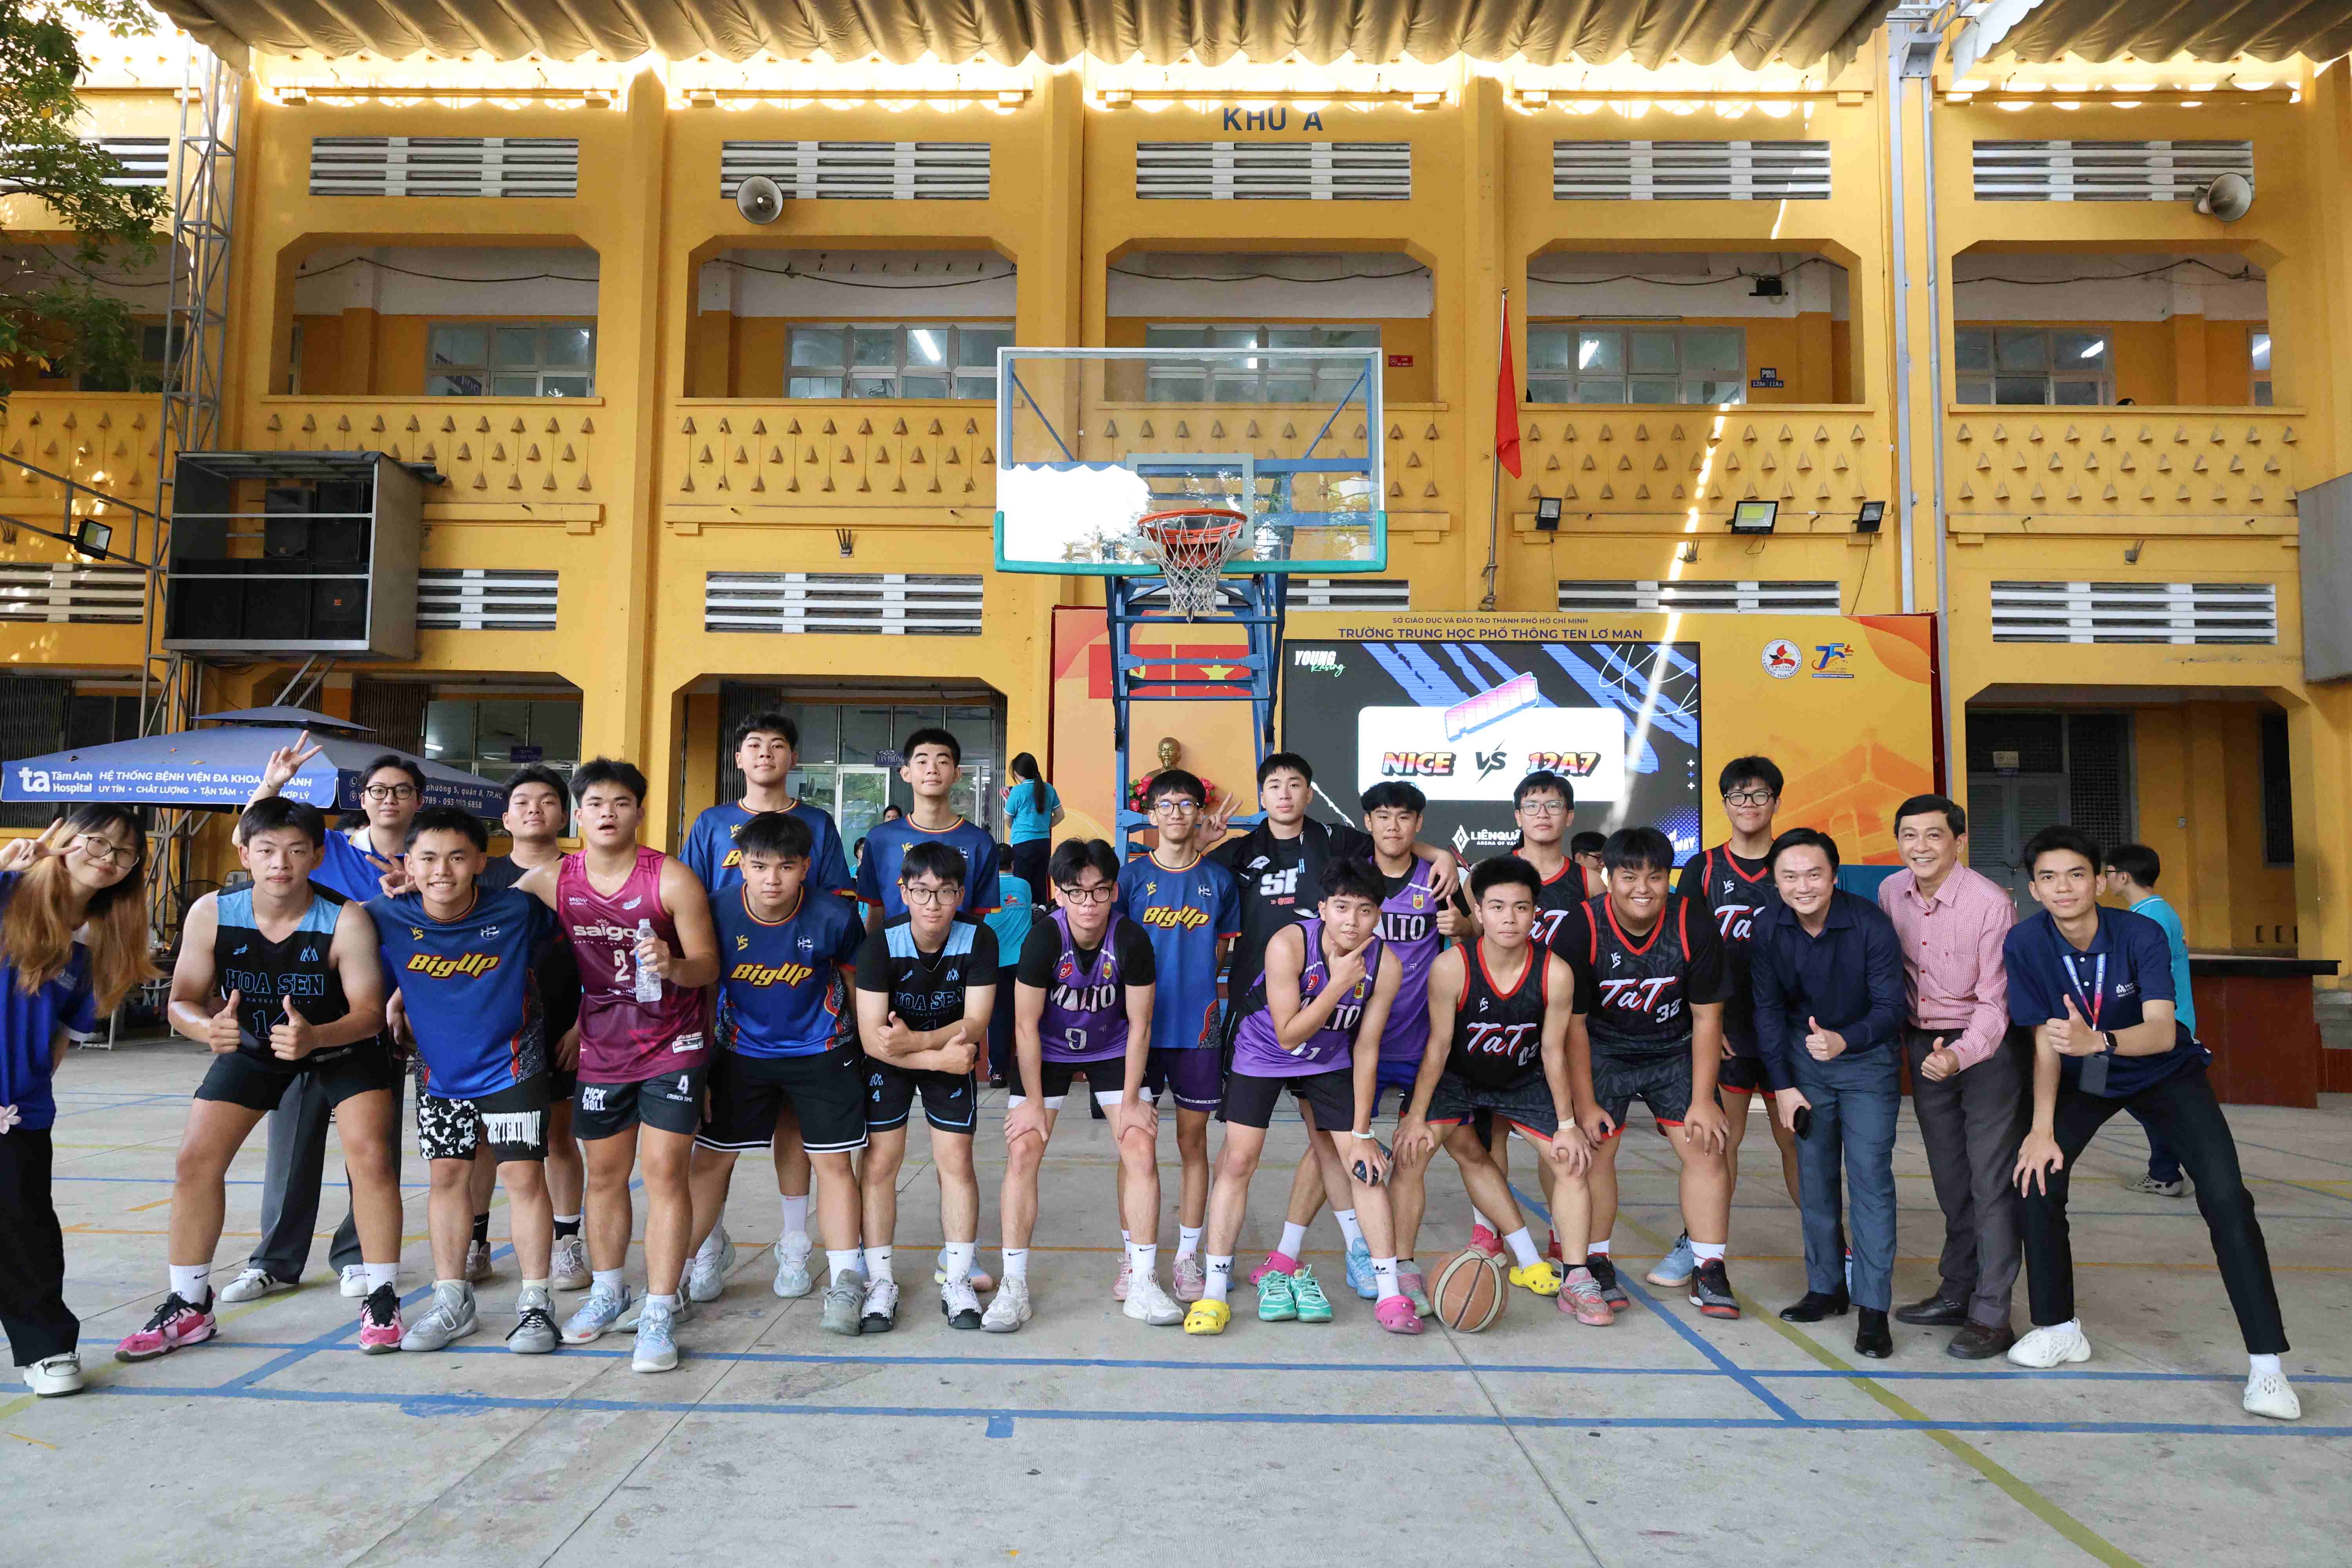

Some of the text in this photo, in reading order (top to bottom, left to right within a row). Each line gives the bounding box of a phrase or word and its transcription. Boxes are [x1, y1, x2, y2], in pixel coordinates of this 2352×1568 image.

[1223, 107, 1323, 131] KHU A
[1392, 615, 1403, 624] SỞ
[1338, 626, 1642, 641] TRƯỜNG TRUNG HỌC PHỔ THÔNG TEN LƠ MAN
[1294, 650, 1337, 666] YOUNG
[1815, 642, 1846, 668] 75
[1310, 664, 1347, 677] Rising
[1381, 751, 1601, 777] NICE VS 12A7
[18, 766, 50, 792] ta
[51, 771, 93, 781] Tâm Anh
[99, 769, 312, 787] HỆ THỐNG BỆNH VIỆN ĐA KHOA ANH
[53, 782, 93, 795] Hospital
[113, 785, 125, 793] TÍN
[136, 785, 158, 794] CHẤT
[159, 786, 189, 796] LƯỢNG
[200, 785, 218, 797] TẬN
[218, 786, 236, 796] TÂM
[279, 790, 298, 800] HỢP
[299, 791, 310, 800] LÝ
[461, 788, 477, 798] quận
[486, 790, 503, 800] TP.HC
[467, 800, 482, 809] 6858
[1470, 829, 1521, 841] LIÊNQUÂ
[1146, 881, 1157, 897] VS
[1723, 880, 1735, 894] VS
[1142, 904, 1210, 930] BigUp
[1528, 906, 1569, 945] aT
[1714, 904, 1766, 940] Ta
[410, 927, 424, 941] VS
[573, 924, 637, 941] saigo
[1372, 913, 1426, 941] ALTO
[735, 934, 749, 951] VS
[407, 953, 501, 978] BigUp
[1611, 952, 1621, 969] VS
[226, 969, 324, 996] HOA SEN
[730, 962, 813, 987] BigUp
[930, 986, 964, 1010] SEN
[1599, 976, 1678, 1013] TaT
[1479, 997, 1488, 1013] VS
[1656, 998, 1682, 1024] 32
[1065, 1027, 1087, 1050] 9
[1466, 1022, 1537, 1056] TaT
[677, 1074, 689, 1094] 4
[584, 1086, 608, 1101] PICK
[666, 1093, 683, 1101] CRUNCH
[872, 1089, 880, 1102] 4
[583, 1099, 606, 1111] ROLL
